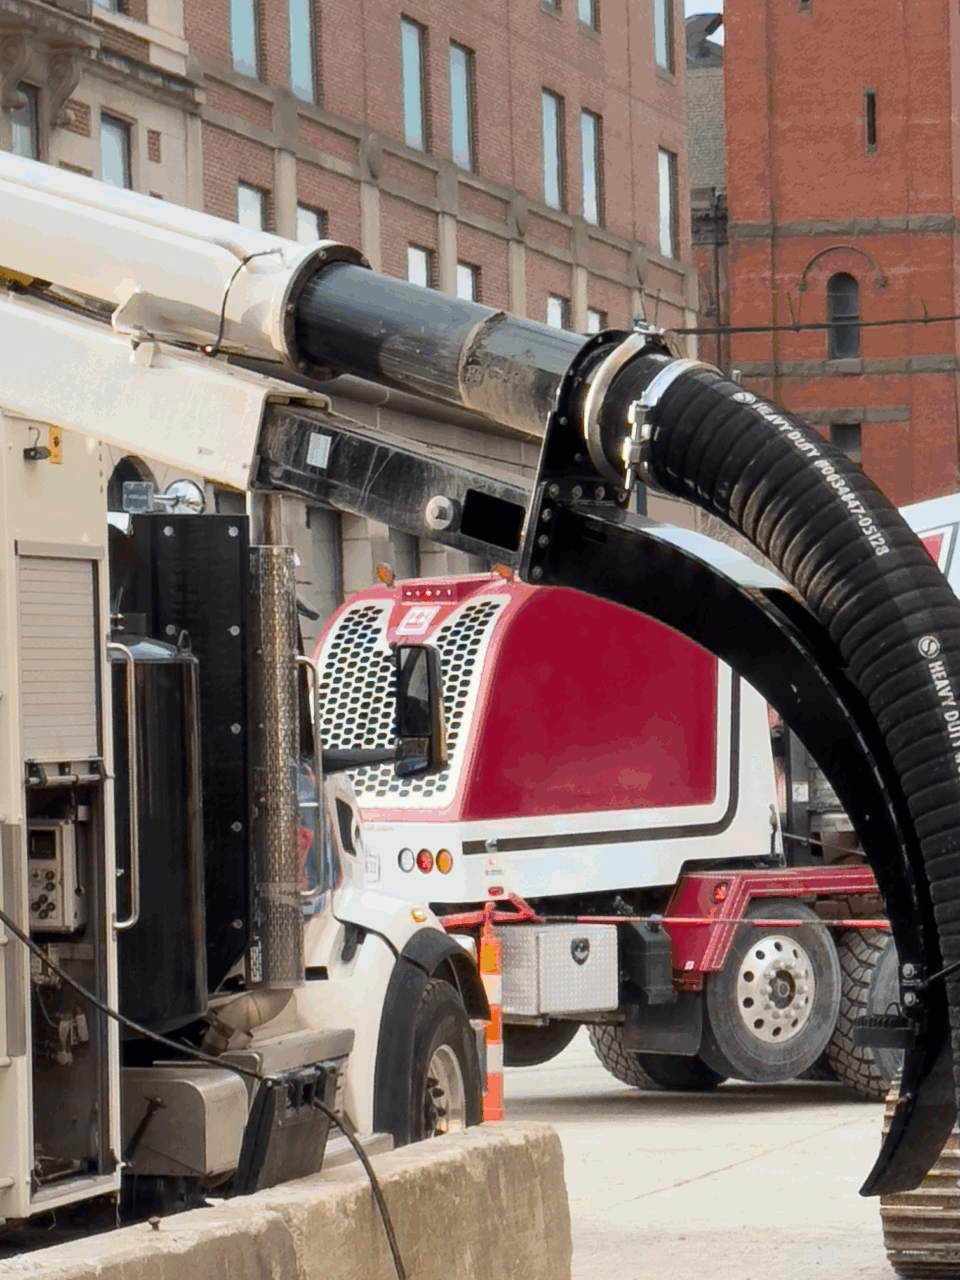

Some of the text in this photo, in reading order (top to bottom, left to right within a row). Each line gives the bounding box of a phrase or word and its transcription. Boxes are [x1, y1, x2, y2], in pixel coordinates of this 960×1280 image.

[752, 402, 792, 432] HEAVY
[787, 429, 821, 457] DUTY
[929, 660, 957, 706] HEAVY
